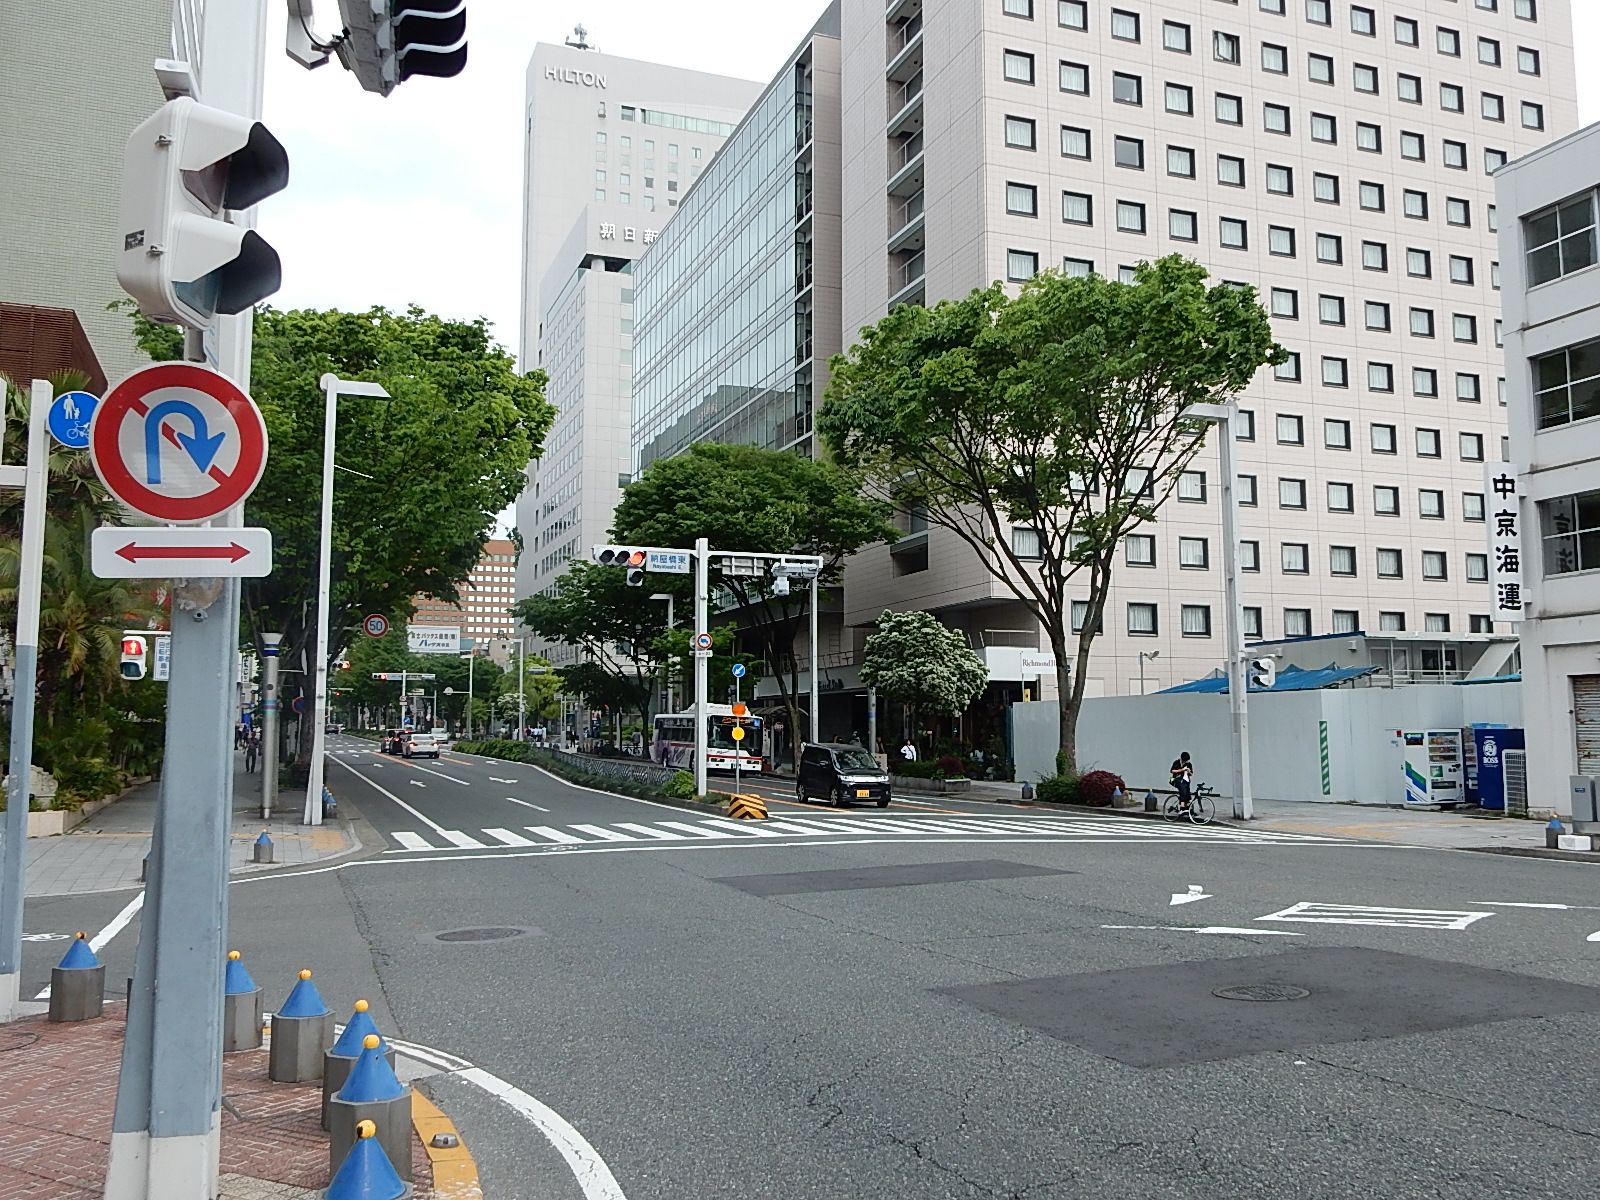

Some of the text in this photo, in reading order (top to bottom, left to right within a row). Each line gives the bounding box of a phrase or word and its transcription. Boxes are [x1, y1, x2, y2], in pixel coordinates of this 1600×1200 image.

[544, 64, 608, 89] HILTON
[1492, 473, 1522, 611] 中京海運
[369, 620, 383, 631] 50
[1022, 658, 1050, 667] Richmond
[1482, 756, 1499, 764] BOSS
